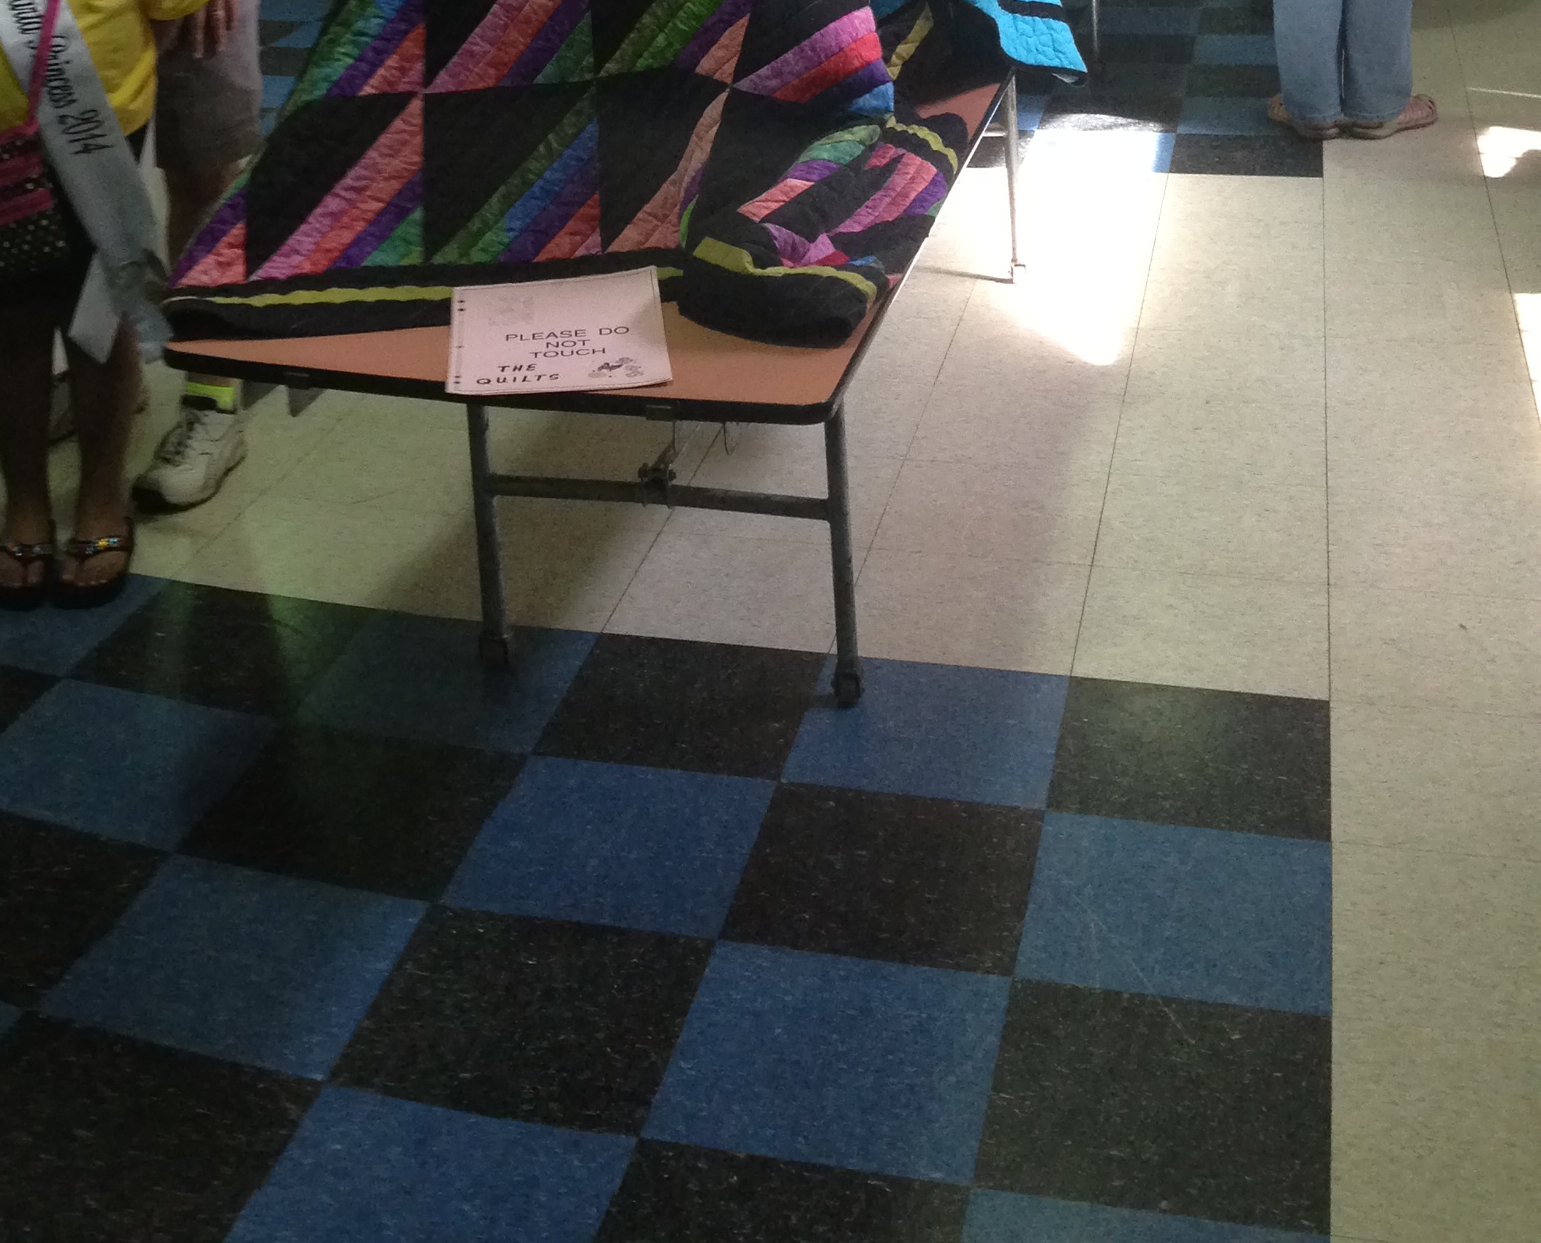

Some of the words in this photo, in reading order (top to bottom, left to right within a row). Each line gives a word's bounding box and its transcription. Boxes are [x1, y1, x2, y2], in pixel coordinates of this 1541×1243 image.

[62, 110, 114, 155] 2014
[505, 329, 587, 342] PLEASE
[599, 326, 630, 336] DO
[545, 339, 591, 349] NOT
[530, 347, 607, 359] TOUCH
[497, 364, 538, 373] THE
[476, 373, 560, 386] QUILTS
